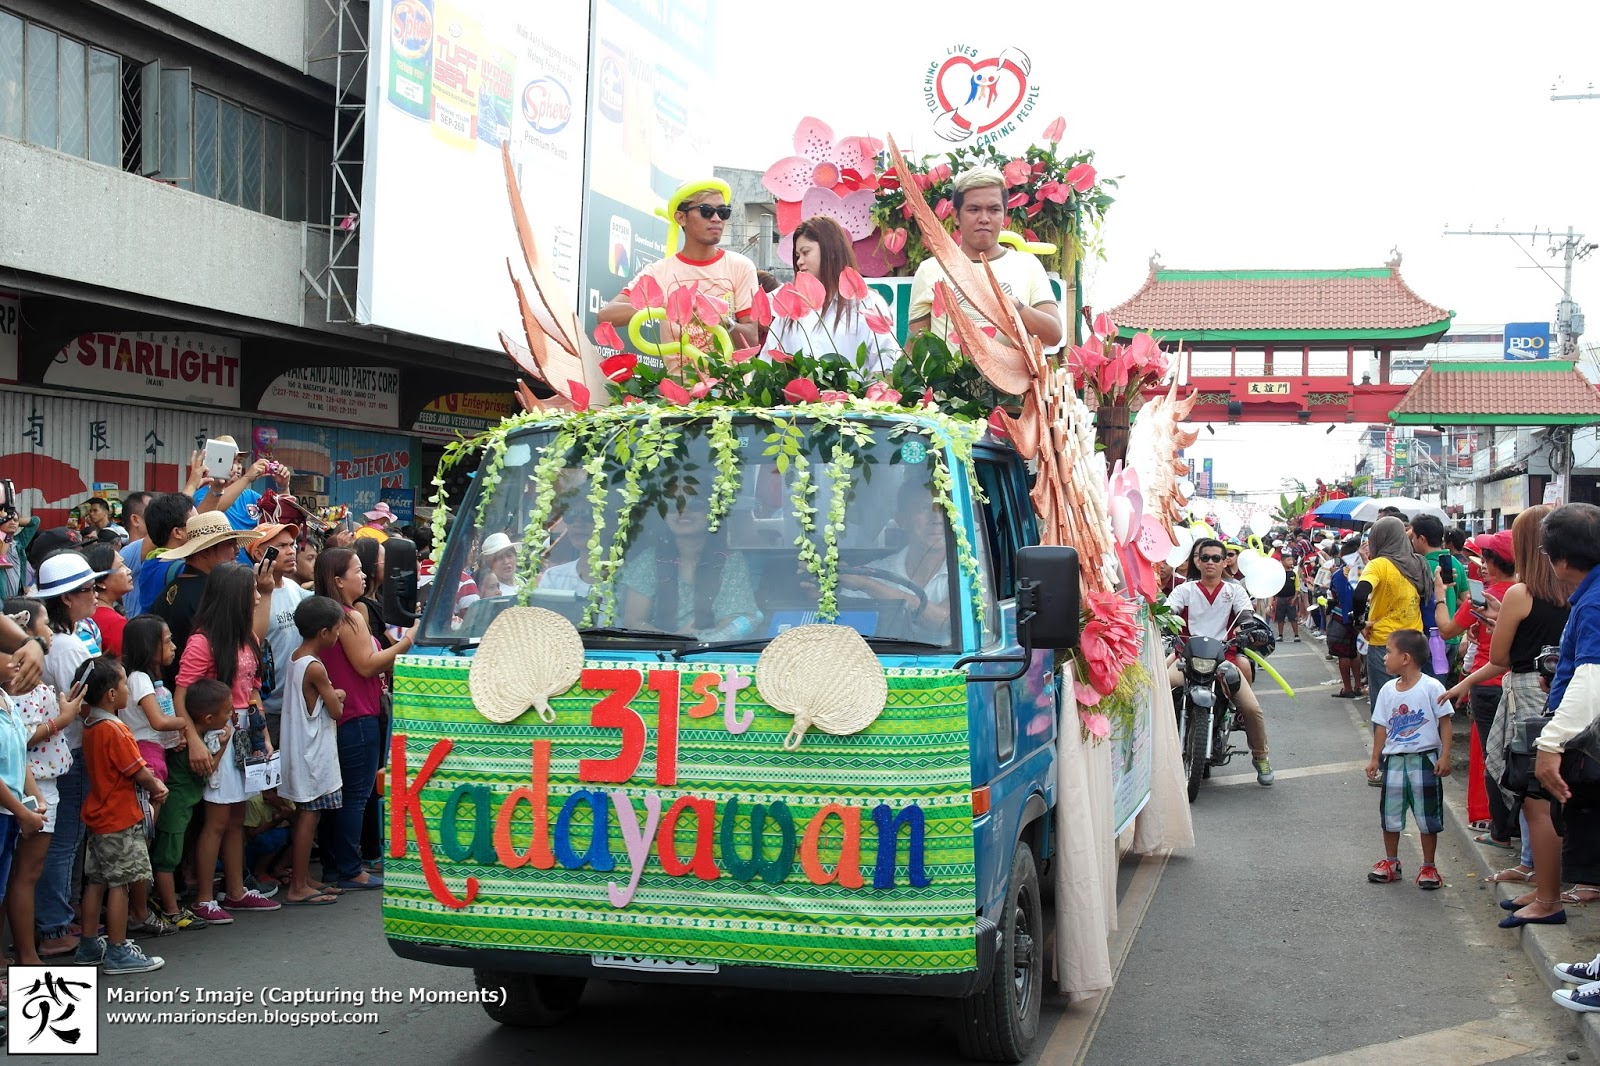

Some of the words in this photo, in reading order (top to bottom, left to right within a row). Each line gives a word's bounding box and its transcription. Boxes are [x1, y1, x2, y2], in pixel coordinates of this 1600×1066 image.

[437, 34, 477, 71] TUFF
[946, 44, 979, 58] LIVES
[433, 57, 475, 98] SEAL
[923, 61, 939, 114] TOUCHING
[976, 121, 1016, 148] CARING
[1016, 85, 1040, 123] PEOPLE
[525, 130, 550, 152] Premium
[550, 142, 568, 161] Paints
[634, 233, 654, 249] Download
[1510, 336, 1545, 349] BDO
[76, 331, 239, 388] STARLIGHT
[145, 376, 164, 388] (MAIN)
[328, 367, 350, 388] AUTO
[351, 367, 377, 392] PARTS
[378, 371, 398, 395] CORP.
[1250, 383, 1288, 394] 友誼門
[367, 392, 377, 400] CITY
[462, 393, 510, 414] Enterprises
[419, 411, 437, 424] FEEDS
[437, 414, 451, 426] AND
[451, 416, 486, 429] VETERINARY
[385, 498, 413, 508] MART
[579, 668, 756, 787] 31st
[389, 735, 932, 909] Kadayawan
